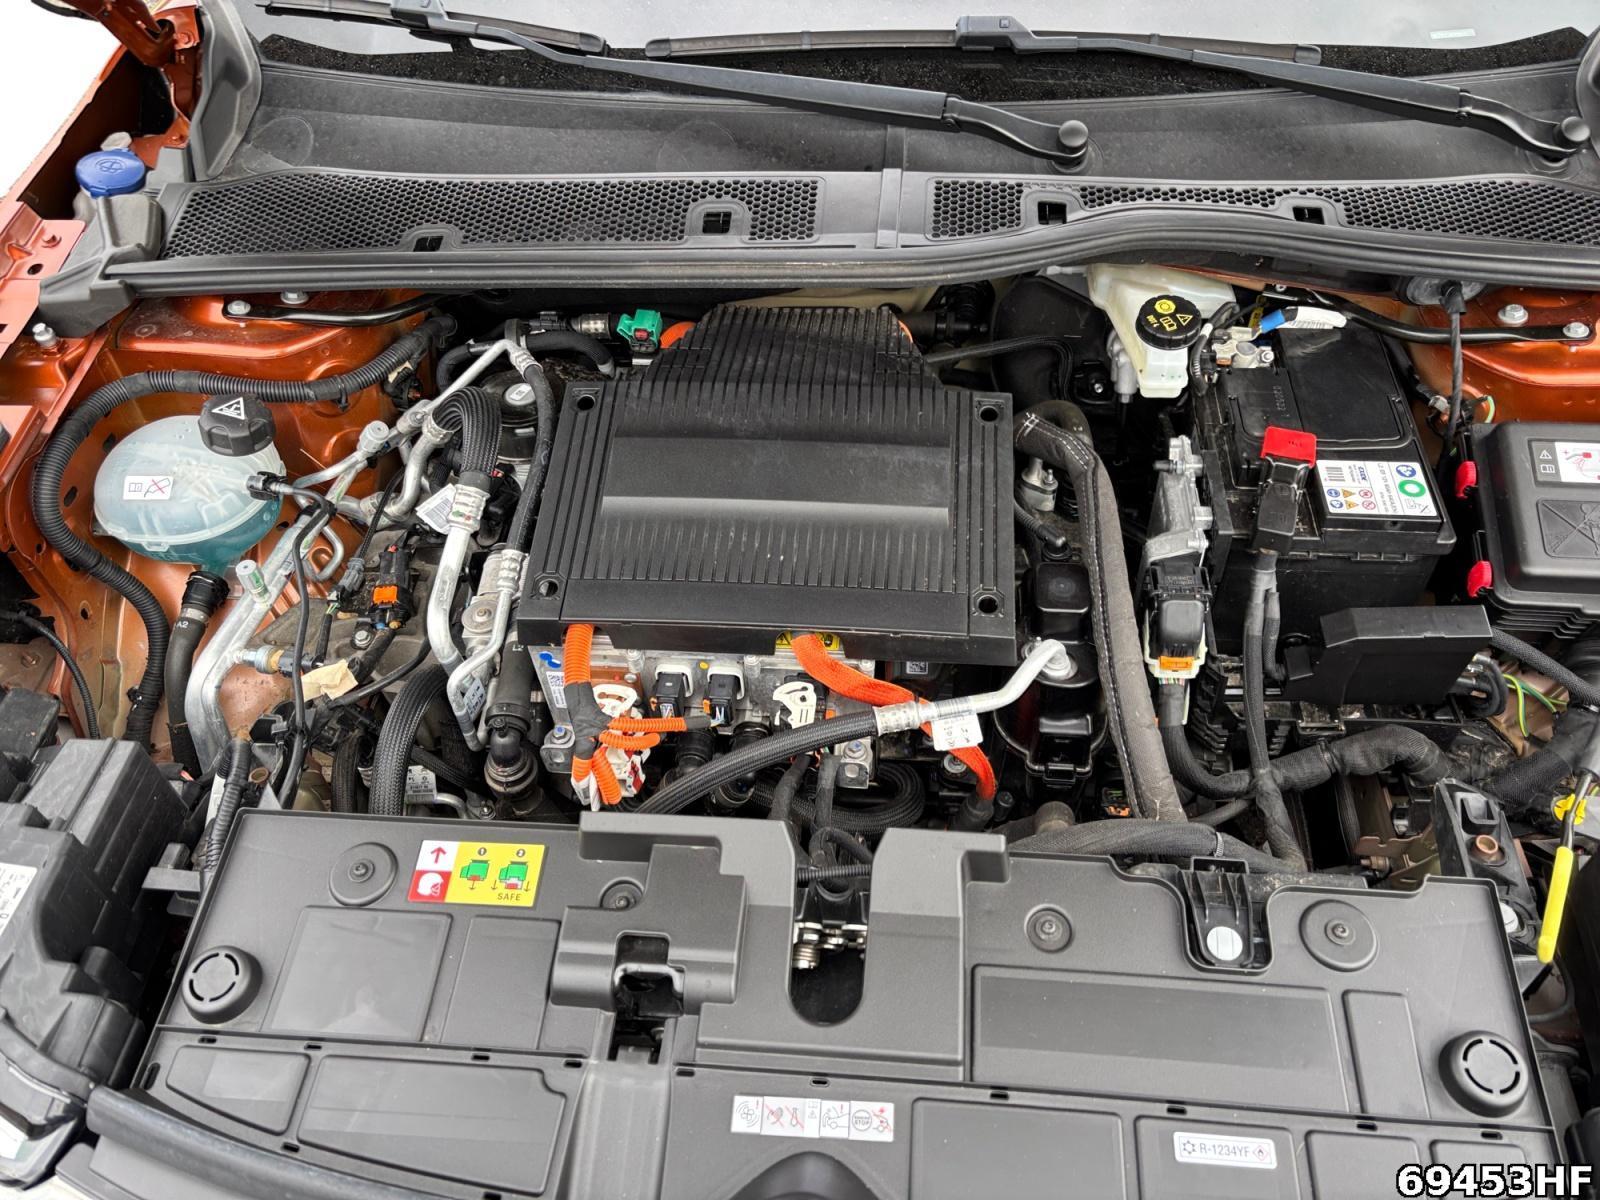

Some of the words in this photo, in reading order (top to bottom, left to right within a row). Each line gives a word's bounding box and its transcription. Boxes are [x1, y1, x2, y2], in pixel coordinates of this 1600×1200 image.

[176, 621, 189, 629] A2
[497, 892, 522, 901] SAFE
[1199, 1143, 1250, 1157] R-1234YF
